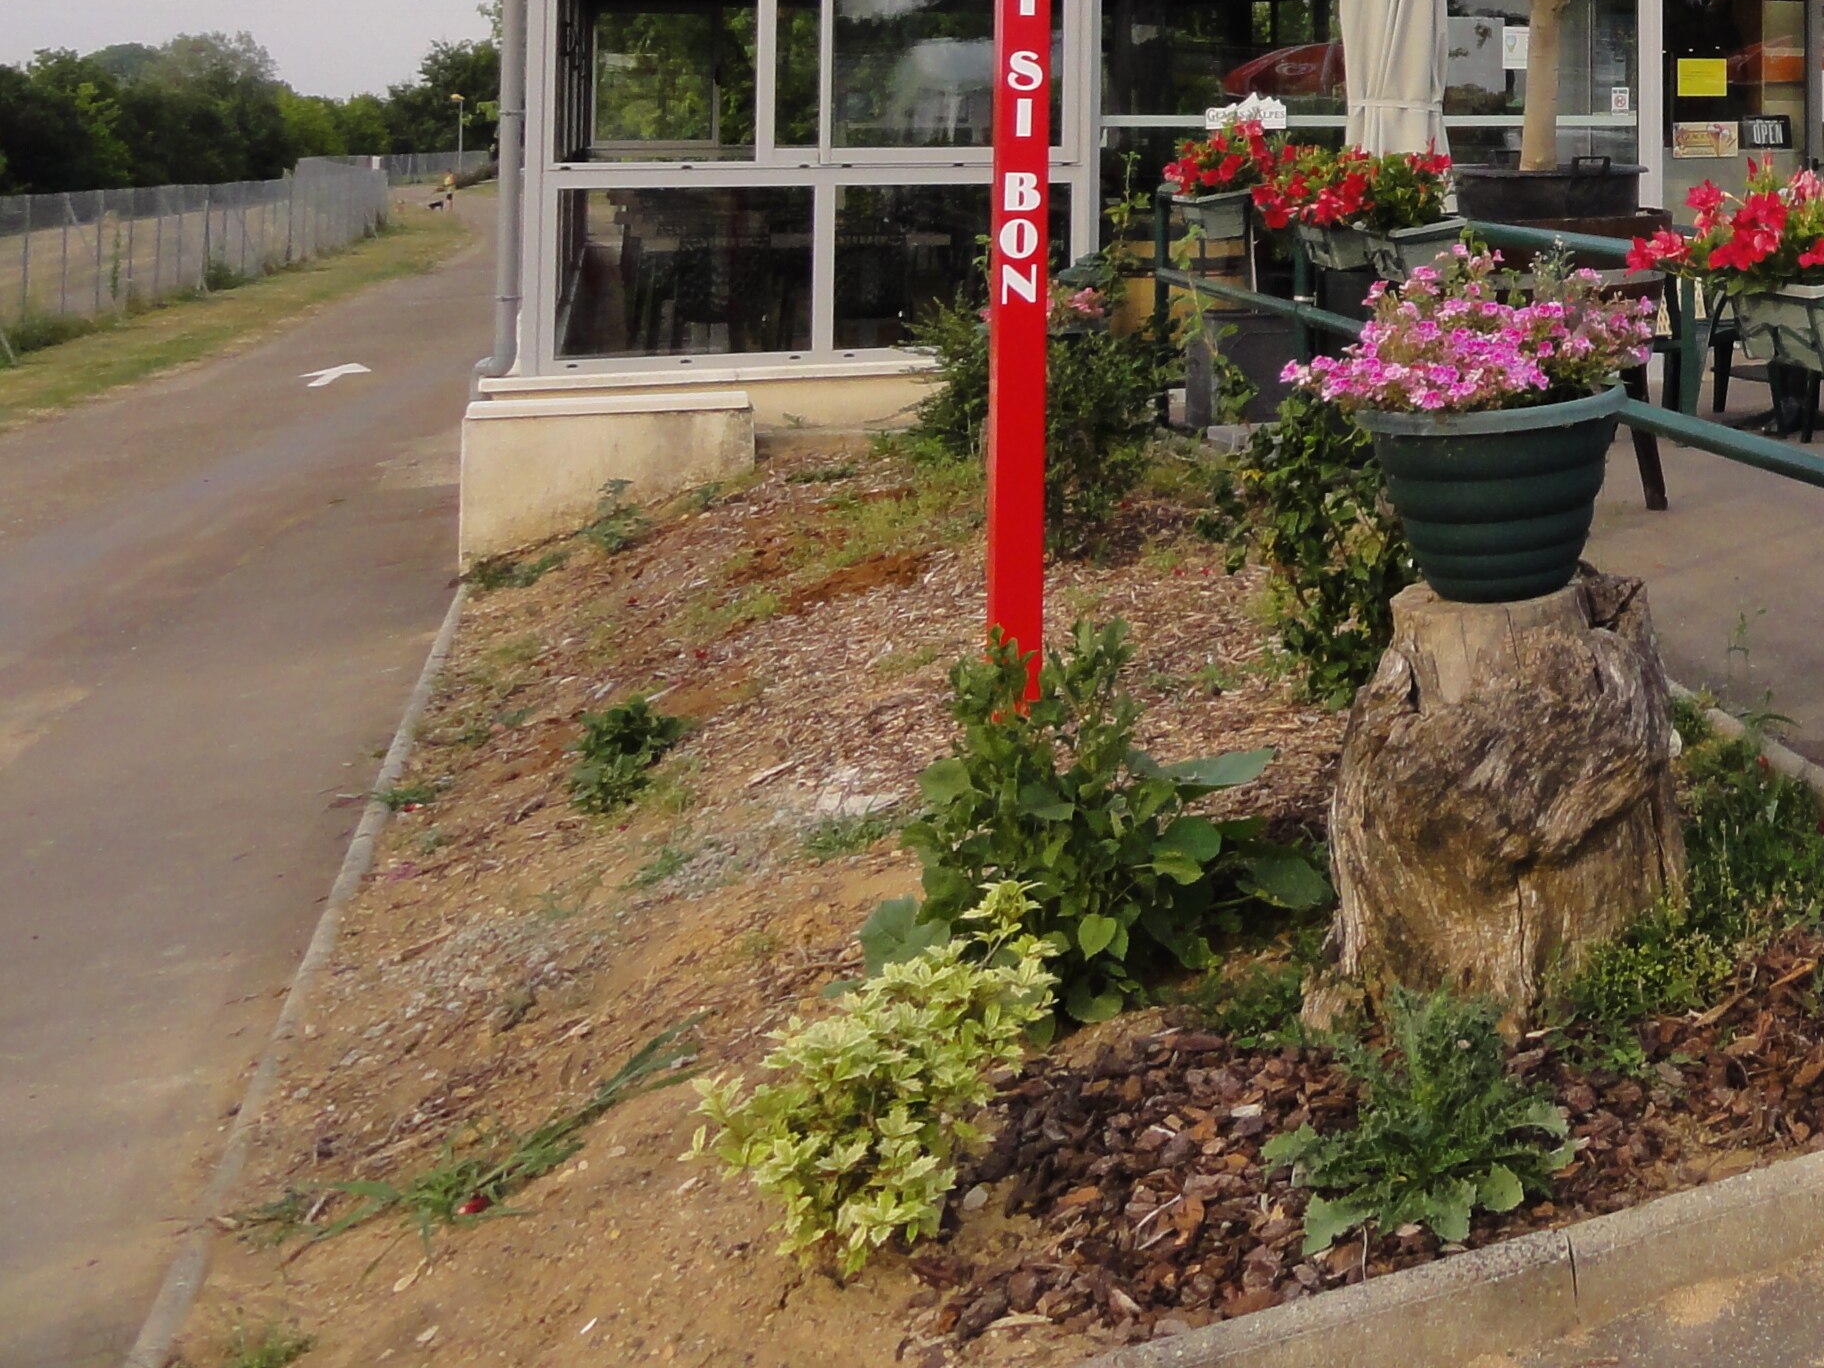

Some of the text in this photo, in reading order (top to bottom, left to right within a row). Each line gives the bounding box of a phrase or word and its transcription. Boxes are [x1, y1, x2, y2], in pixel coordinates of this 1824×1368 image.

[1007, 50, 1044, 137] SI
[1753, 123, 1784, 144] OPEN
[999, 172, 1041, 305] BON
